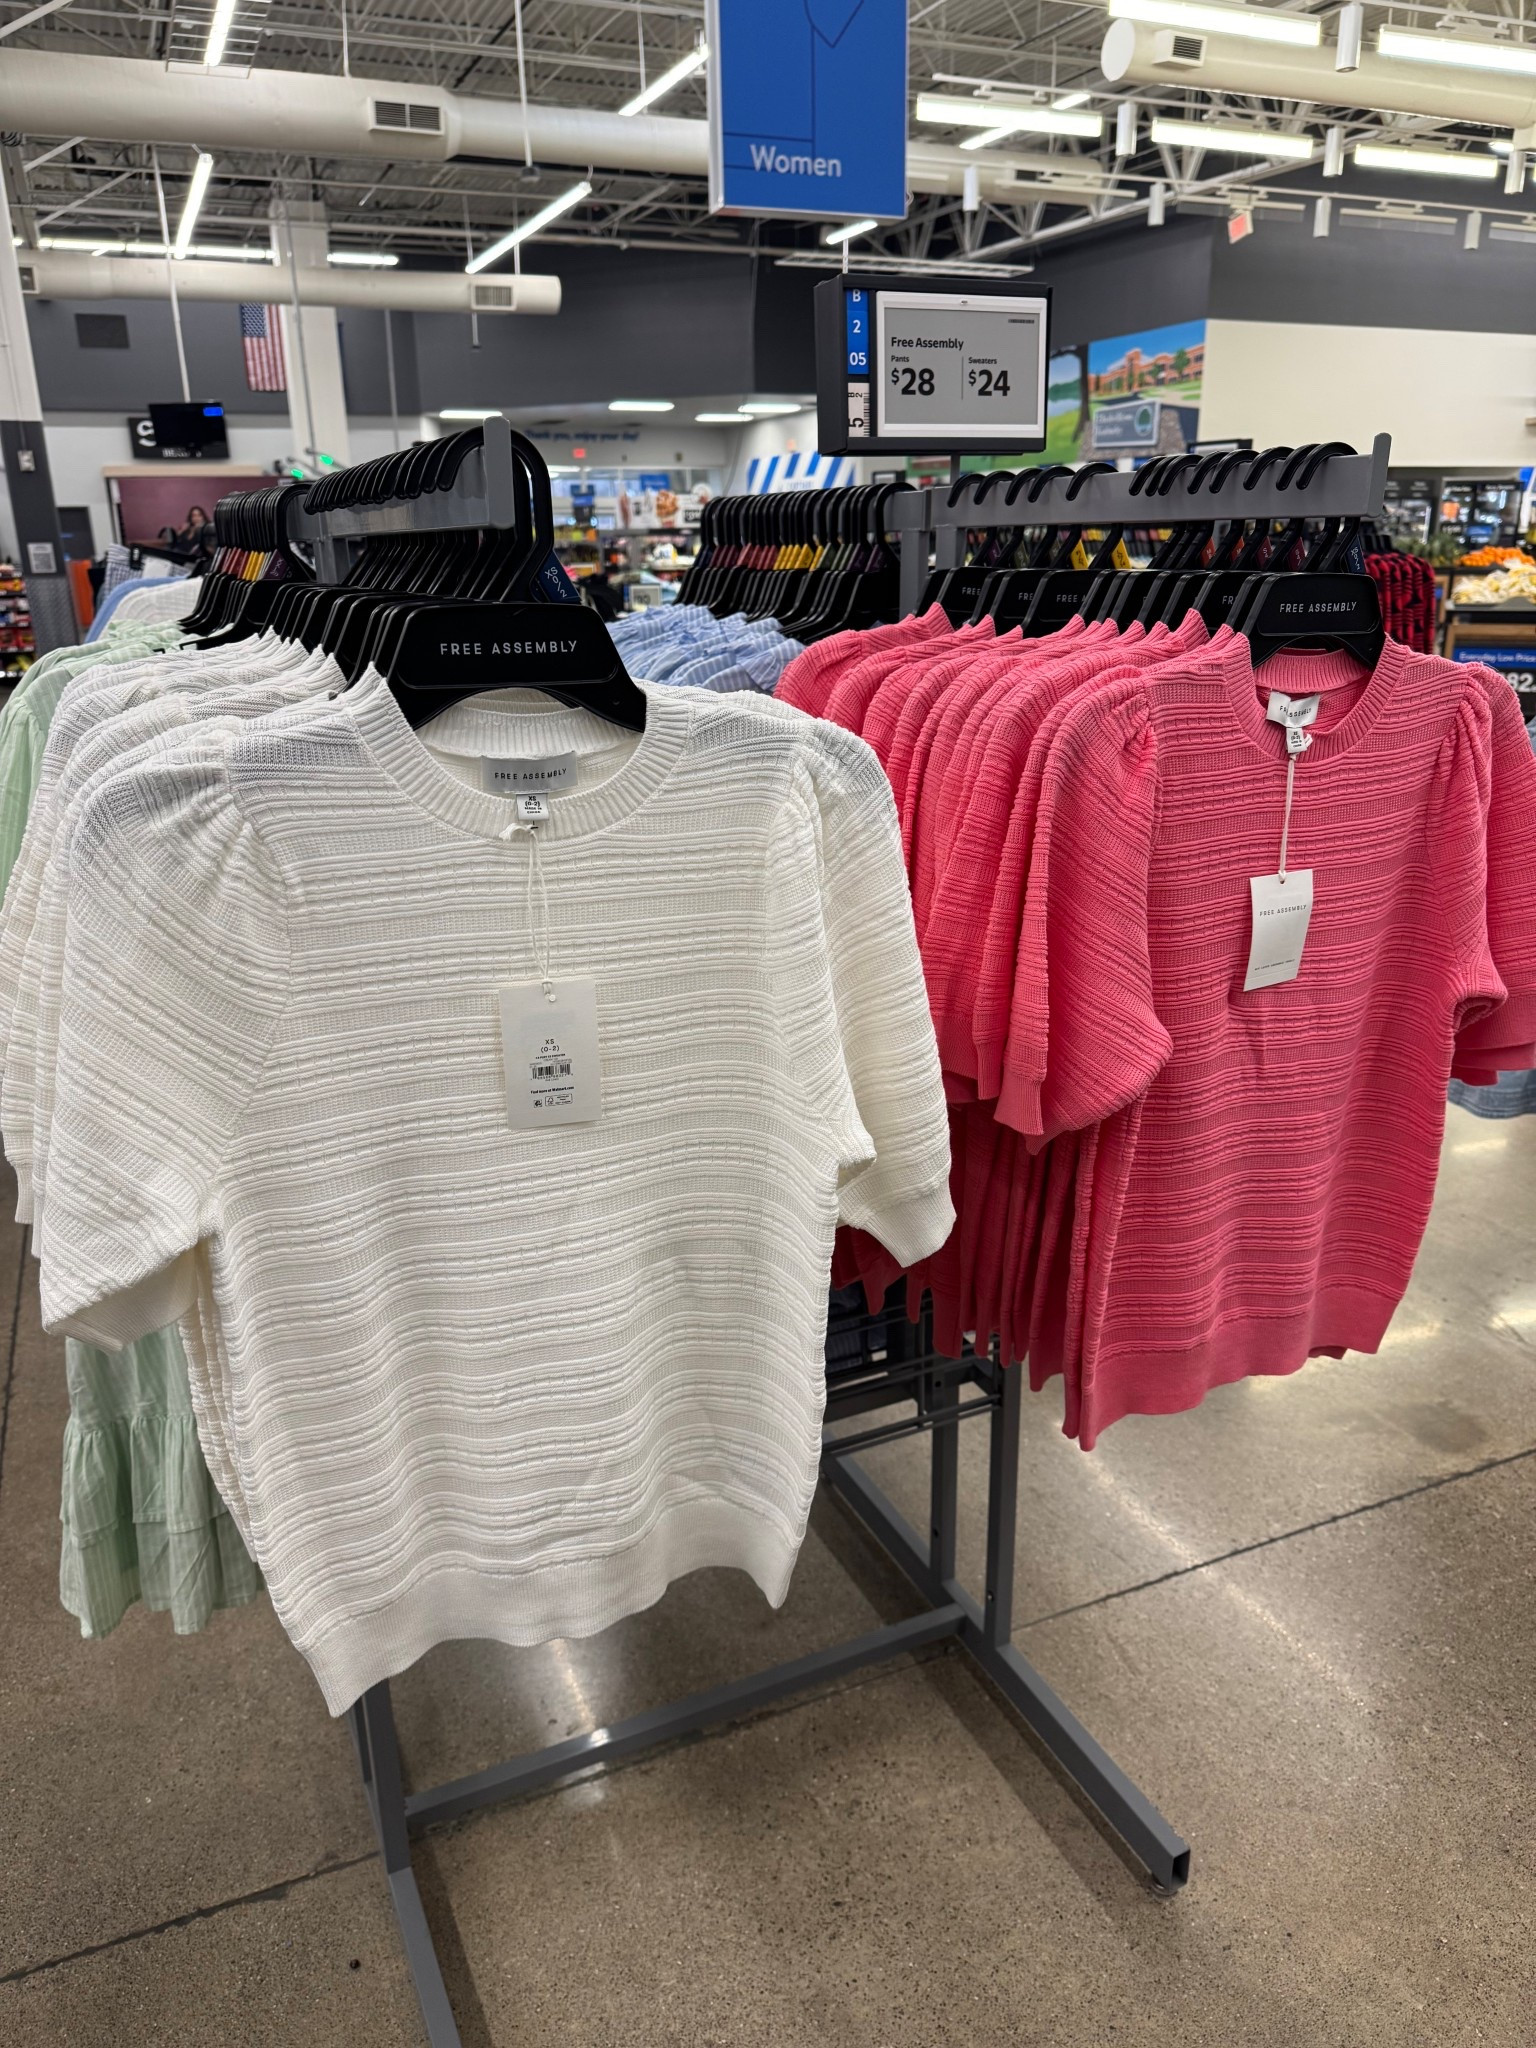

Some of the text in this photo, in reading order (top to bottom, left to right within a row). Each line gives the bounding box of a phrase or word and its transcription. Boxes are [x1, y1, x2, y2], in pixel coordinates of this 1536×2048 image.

[749, 143, 842, 178] Women
[852, 289, 862, 302] B
[852, 320, 862, 334] 2
[890, 336, 964, 351] Free Assembly
[849, 351, 867, 366] 05
[890, 355, 910, 363] Pants
[968, 356, 998, 365] Sweaters
[890, 367, 935, 396] $28
[968, 369, 1011, 397] $24
[544, 566, 559, 579] XS
[1056, 594, 1078, 603] FREE
[1279, 601, 1357, 613] FREE ASSEMBLY
[440, 640, 577, 655] FREE ASSEMBLY
[494, 768, 567, 780] FREE ASSEMBLY
[1259, 903, 1307, 917] FREE ASSEMBLY
[545, 1038, 555, 1046] XS
[540, 1045, 560, 1053] (0-2)
